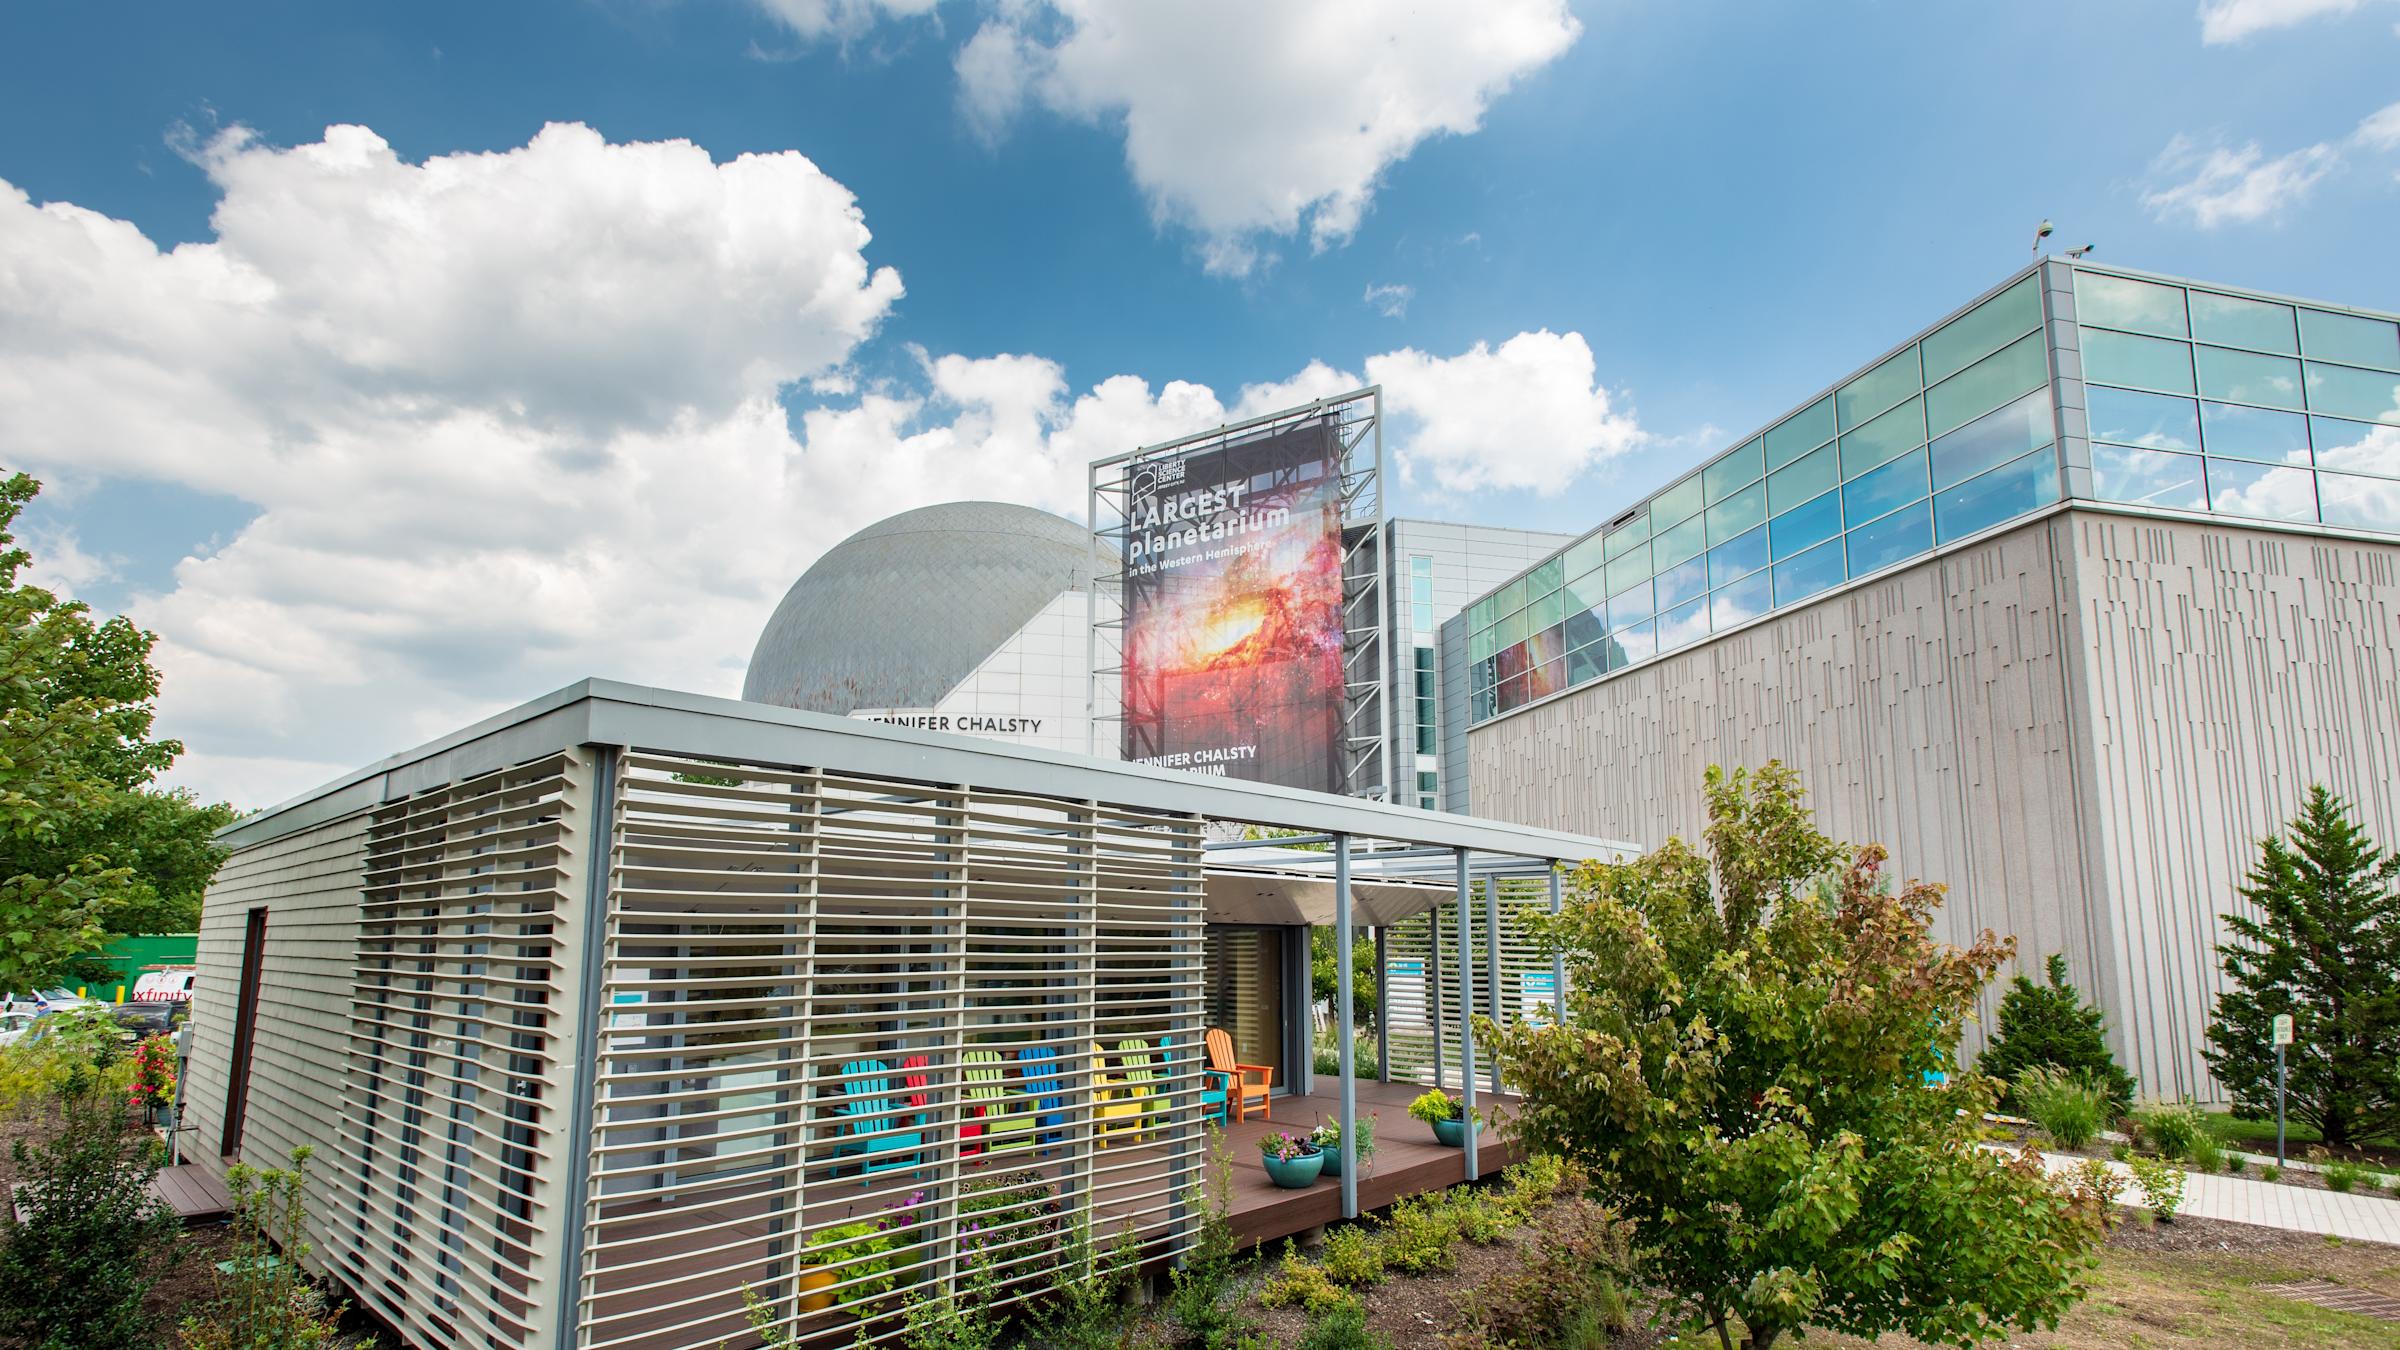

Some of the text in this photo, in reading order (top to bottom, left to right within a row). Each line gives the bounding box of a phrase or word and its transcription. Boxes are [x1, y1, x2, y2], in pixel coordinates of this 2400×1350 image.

[1158, 459, 1186, 471] LIBERTY
[1158, 465, 1186, 477] SCIENCE
[1157, 471, 1185, 483] CENTER
[1130, 484, 1246, 533] LARGEST
[1129, 507, 1290, 565] planetarium
[1129, 567, 1138, 577] in
[1140, 563, 1157, 575] the
[1159, 554, 1202, 571] Western
[868, 716, 1042, 733] NNIFER CHALSTY
[1193, 745, 1257, 764] CHALSTY
[1182, 764, 1226, 777] RIUM
